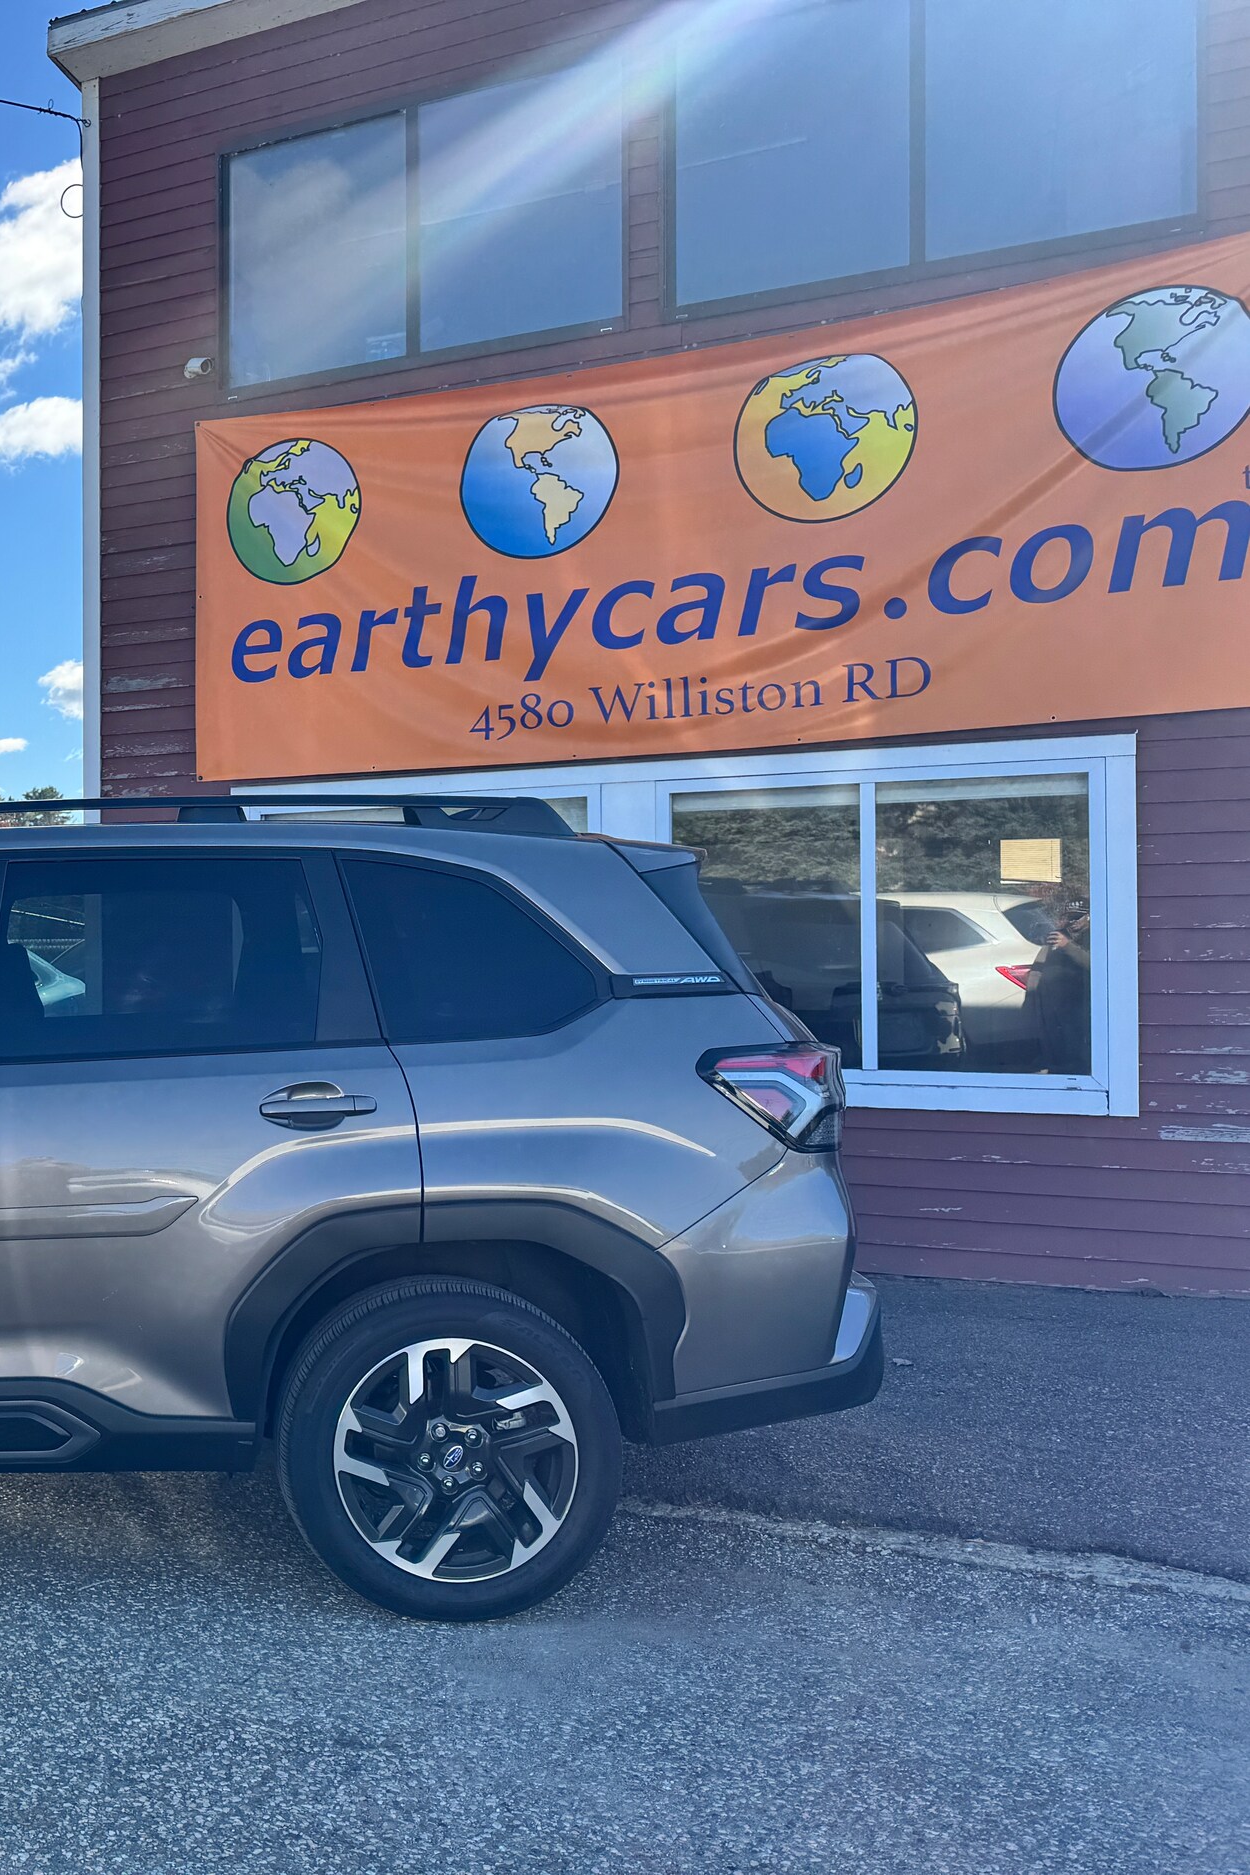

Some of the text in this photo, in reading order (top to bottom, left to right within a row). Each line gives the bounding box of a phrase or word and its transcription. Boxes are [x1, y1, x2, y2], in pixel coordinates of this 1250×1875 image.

[231, 500, 1250, 681] earthycars.com
[469, 655, 932, 741] 4580 Williston RD
[681, 976, 721, 984] AWD
